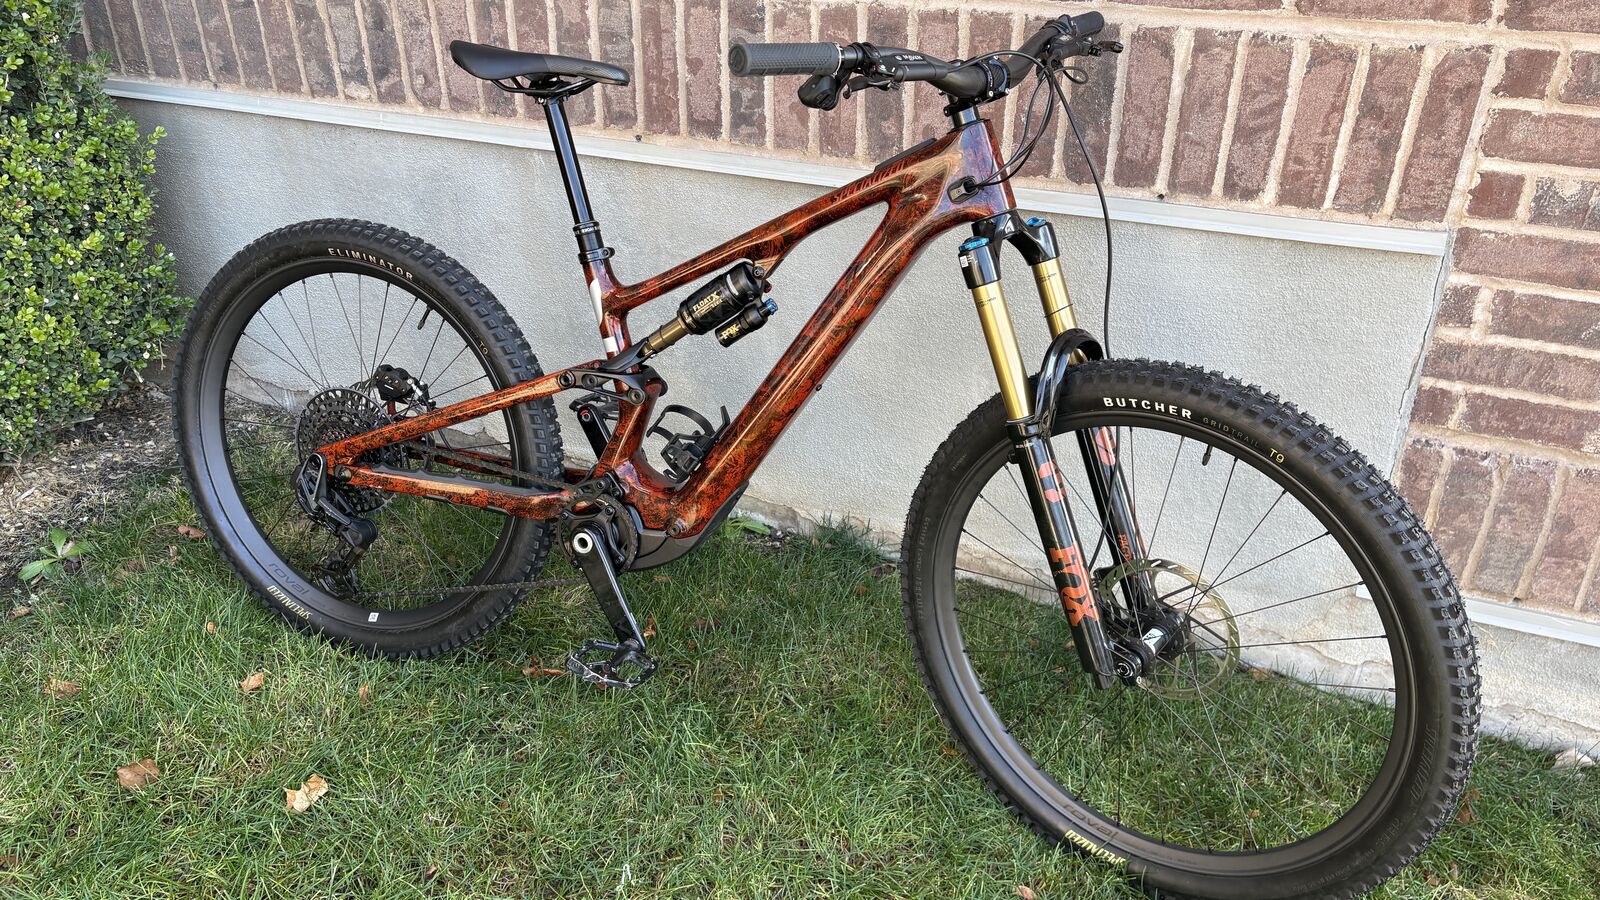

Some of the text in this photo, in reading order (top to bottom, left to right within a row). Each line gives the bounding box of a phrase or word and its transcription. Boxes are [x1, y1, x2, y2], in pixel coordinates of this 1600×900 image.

[328, 247, 413, 280] ELIMINATOR
[720, 323, 740, 339] FOX
[1103, 397, 1192, 420] BUTCHER
[1269, 448, 1285, 464] T9
[268, 562, 310, 596] roval
[1049, 540, 1101, 627] FOX
[266, 585, 313, 620] SPECIALIZED
[1062, 804, 1119, 839] roval
